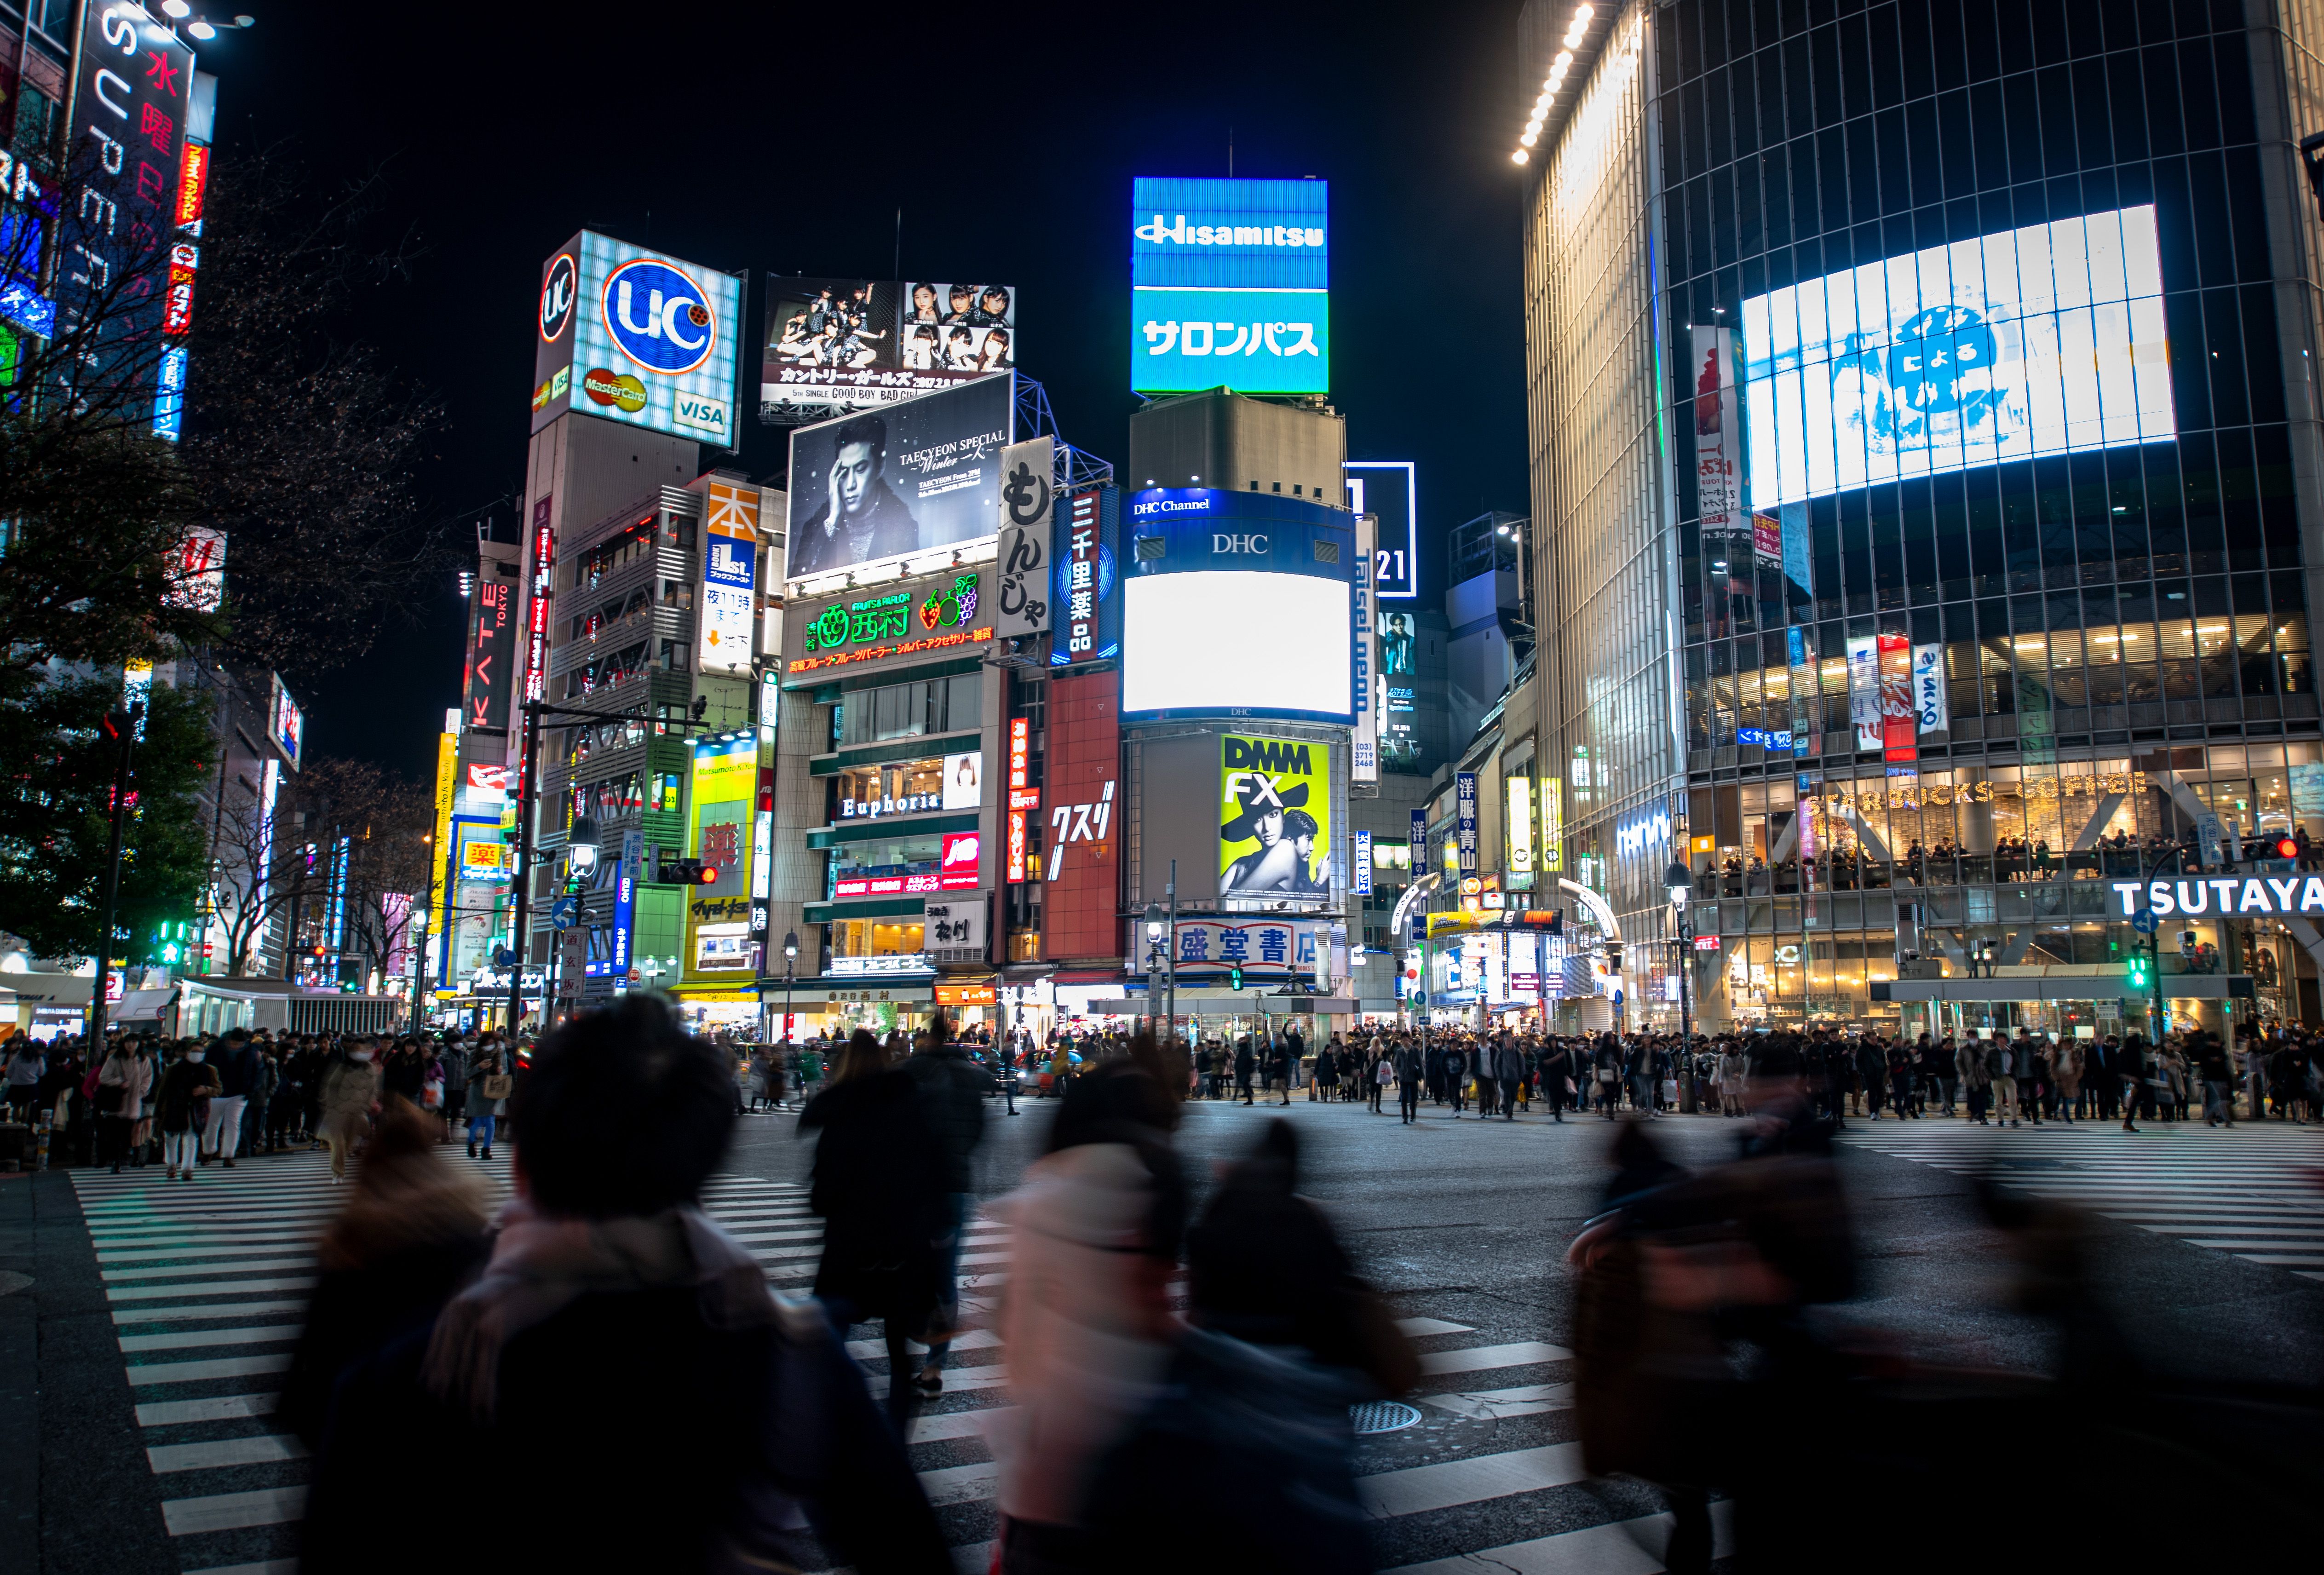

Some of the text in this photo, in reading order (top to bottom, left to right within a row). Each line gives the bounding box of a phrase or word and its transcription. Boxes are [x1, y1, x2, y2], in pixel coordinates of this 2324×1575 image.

[1135, 214, 1323, 247] Hisamitsu
[618, 280, 705, 350] UC
[1143, 321, 1318, 357] サロンパス
[1904, 343, 1977, 372] による
[553, 372, 569, 392] VISA
[585, 377, 646, 403] MasterCard
[780, 368, 913, 386] カントリー・ガールズ
[806, 390, 829, 398] SINGLE
[832, 387, 856, 399] GOOD
[859, 389, 875, 400] BOY
[880, 390, 898, 401] BAD
[680, 401, 724, 426] VISA
[900, 430, 1005, 466] TAECYEON SPECIAL
[1134, 498, 1209, 515] DHC Channel
[712, 546, 720, 568] BOOK
[1002, 461, 1049, 627] もんじゃ
[1212, 534, 1268, 554] DHC
[710, 571, 750, 583] ブックファースト
[1070, 497, 1093, 651] 三千里薬品
[496, 586, 507, 627] TOKYO
[851, 605, 910, 643] 西村
[698, 765, 736, 776] Matsumoto
[1225, 737, 1312, 775] DMM
[842, 791, 938, 818] Euphoria
[1225, 771, 1284, 807] FX
[1804, 771, 2147, 817] STARBUCKS COFFEE
[1459, 778, 1476, 870] 洋服の青山
[471, 845, 496, 865] 薬
[630, 834, 642, 875] 渋谷駅前
[703, 821, 740, 867] 薬
[927, 906, 950, 917] うなぎ
[2113, 878, 2324, 915] TSUTAYA
[935, 919, 969, 942] 松川
[564, 934, 578, 990] 道玄坂
[1773, 993, 1852, 1002] STARBUCKS COFFEE
